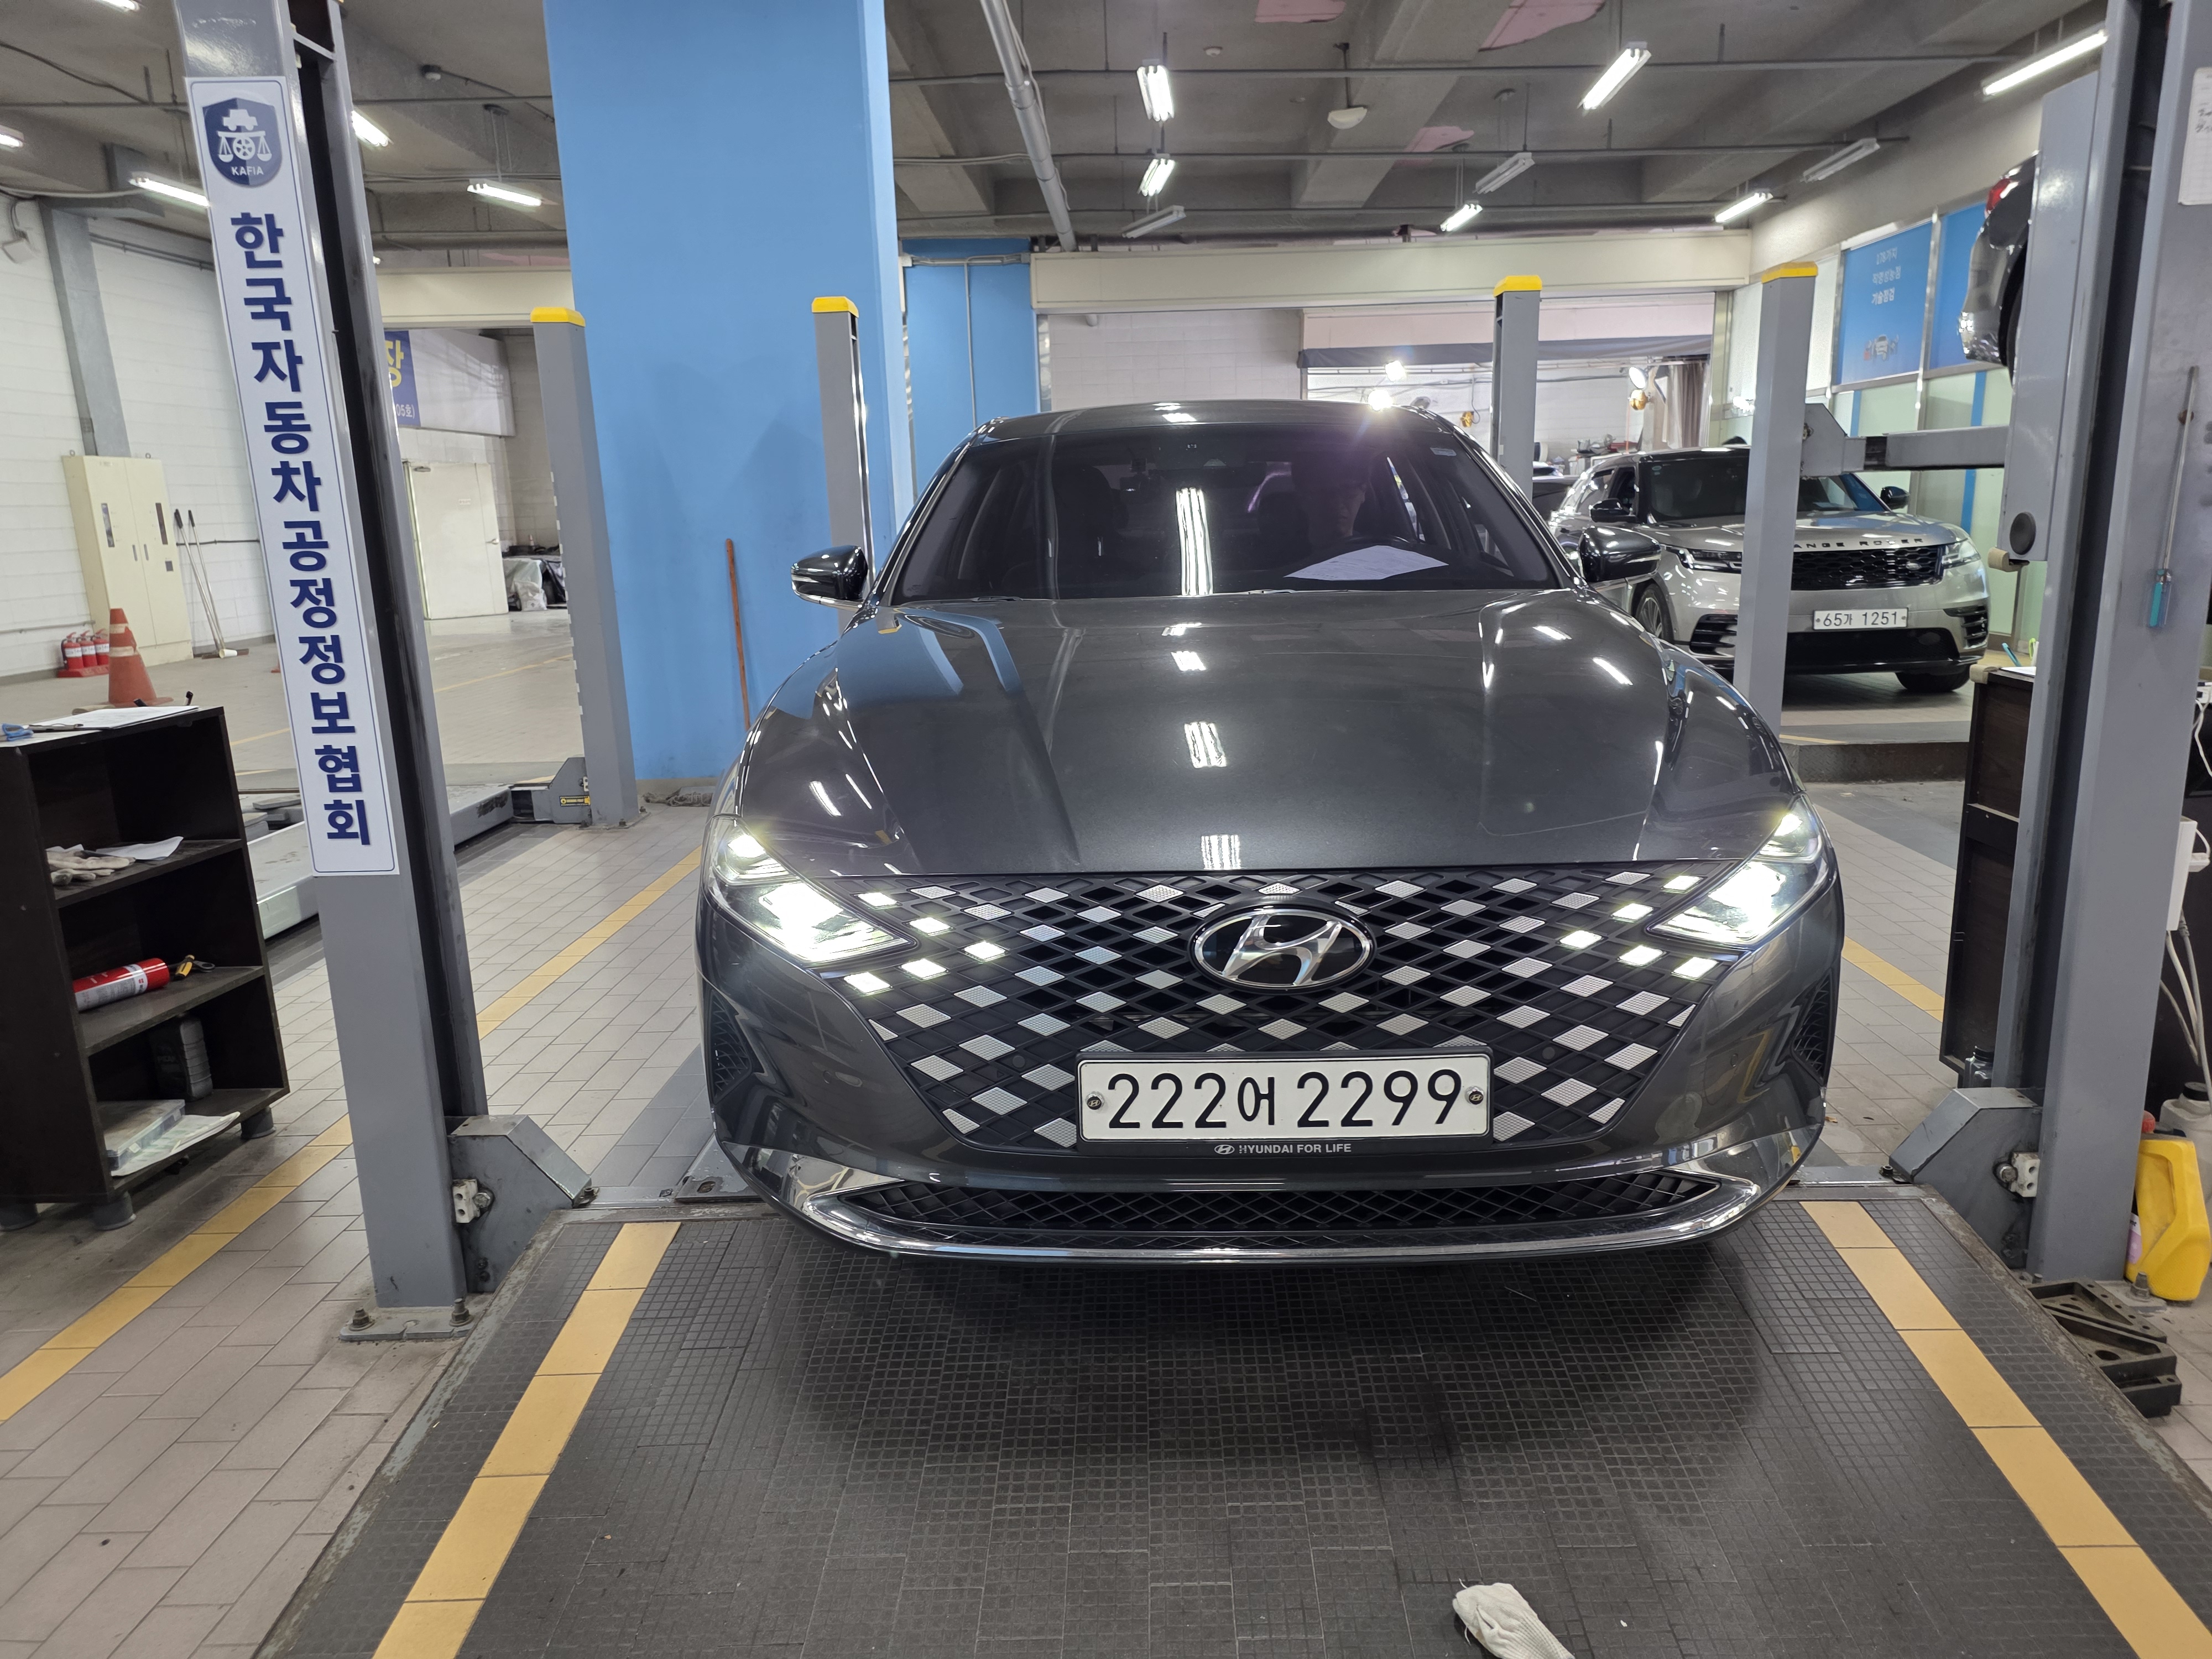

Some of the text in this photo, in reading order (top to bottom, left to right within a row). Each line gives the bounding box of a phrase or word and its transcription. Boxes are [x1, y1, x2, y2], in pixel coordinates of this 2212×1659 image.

[231, 166, 264, 176] KAFIA
[1823, 611, 1897, 627] 65가 1251
[1108, 1068, 1463, 1129] 222어 2299
[1239, 1143, 1352, 1154] HYUNDAI FOR LIFE
